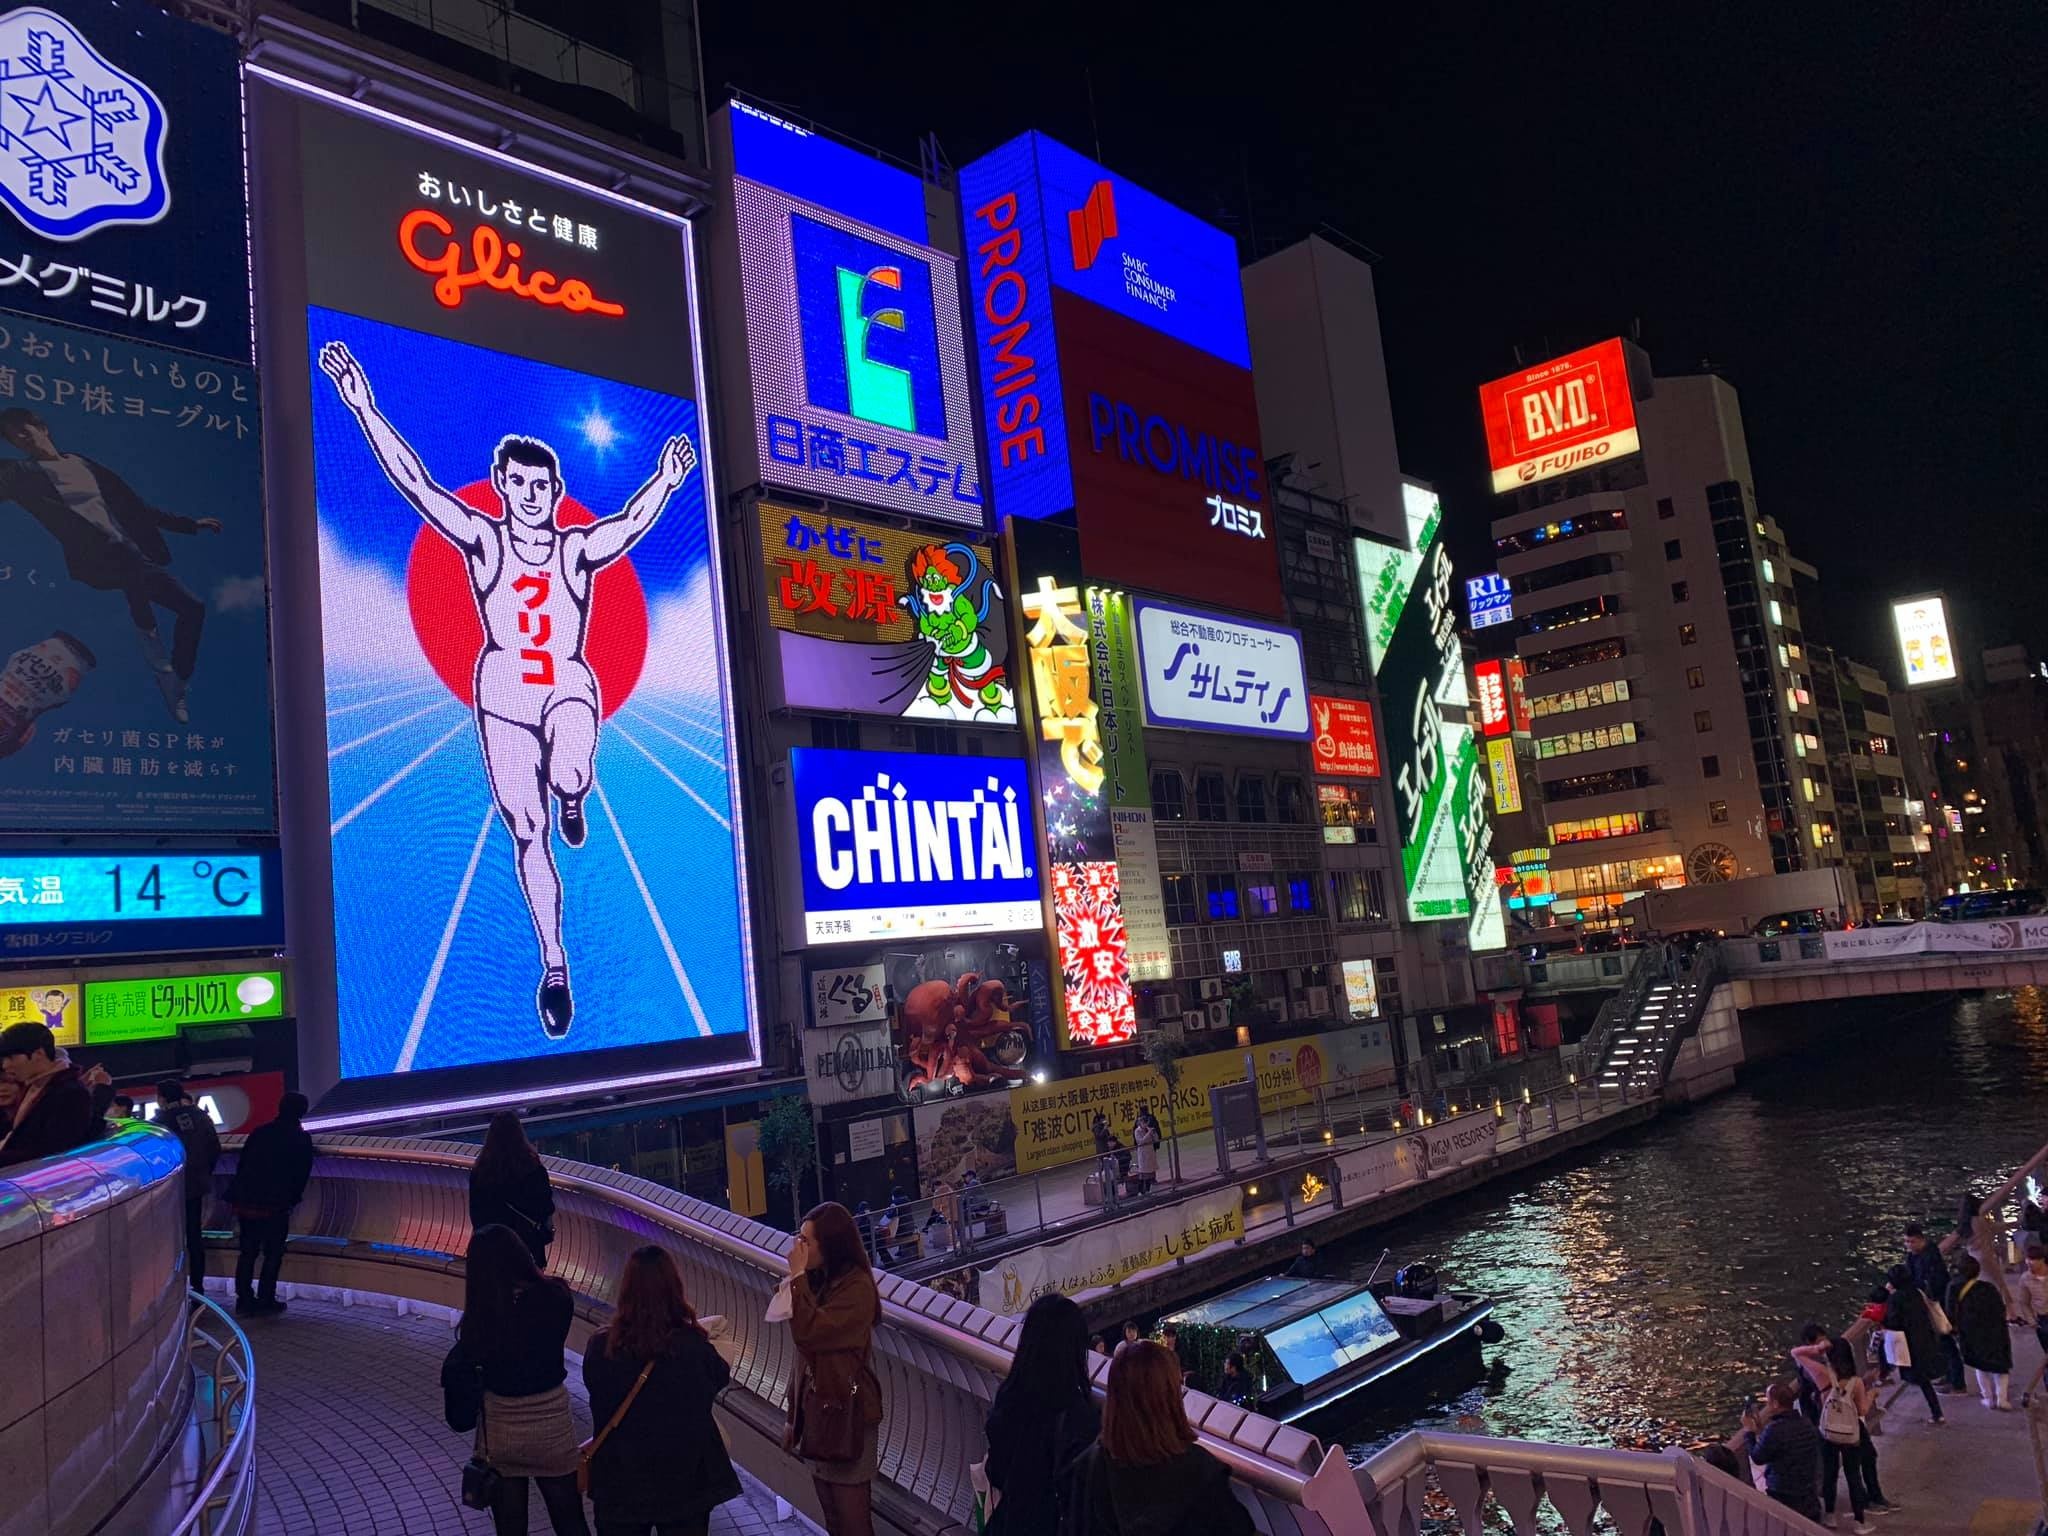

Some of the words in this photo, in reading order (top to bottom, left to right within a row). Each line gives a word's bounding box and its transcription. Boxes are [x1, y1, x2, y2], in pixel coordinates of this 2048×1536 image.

[418, 171, 597, 249] おいしさと健康
[400, 209, 625, 312] Glico
[1122, 252, 1149, 275] SMBC
[1124, 267, 1176, 302] CONSUMER
[1126, 281, 1168, 312] FINANCE
[976, 192, 1045, 467] PROMISE
[1526, 370, 1549, 383] Since
[1522, 378, 1597, 441] B.V.D.
[768, 415, 985, 505] 日商エステム
[1088, 391, 1262, 501] PROMISE
[1541, 442, 1610, 473] FUJIBO
[1206, 495, 1265, 538] プロミス
[784, 515, 884, 564] かぜに
[774, 556, 898, 624] 改源
[512, 571, 555, 686] グリコ
[1170, 619, 1281, 652] 総合不動産のプロデューサー
[1091, 594, 1126, 801] 株式会社日本リート
[1188, 662, 1270, 707] サムティ
[53, 728, 225, 751] ガセリ菌SP株が
[54, 756, 238, 777] 内臓脂肪を減らす
[812, 772, 1025, 890] CHINTAI
[1112, 811, 1146, 823] NIHON
[0, 876, 64, 905] 気温
[105, 864, 166, 912] 14
[3, 930, 113, 948] 雪印メグミルク
[815, 920, 852, 935] 天気予報
[1076, 915, 1115, 982] 激安
[91, 991, 147, 1020] 賃貸・売買
[151, 980, 231, 1020] ピタットハウス
[1022, 1076, 1158, 1115] 从这里到大阪最大级别的购物中心
[1452, 1121, 1495, 1151] RESORTS
[1164, 1211, 1236, 1256] しまだ病院
